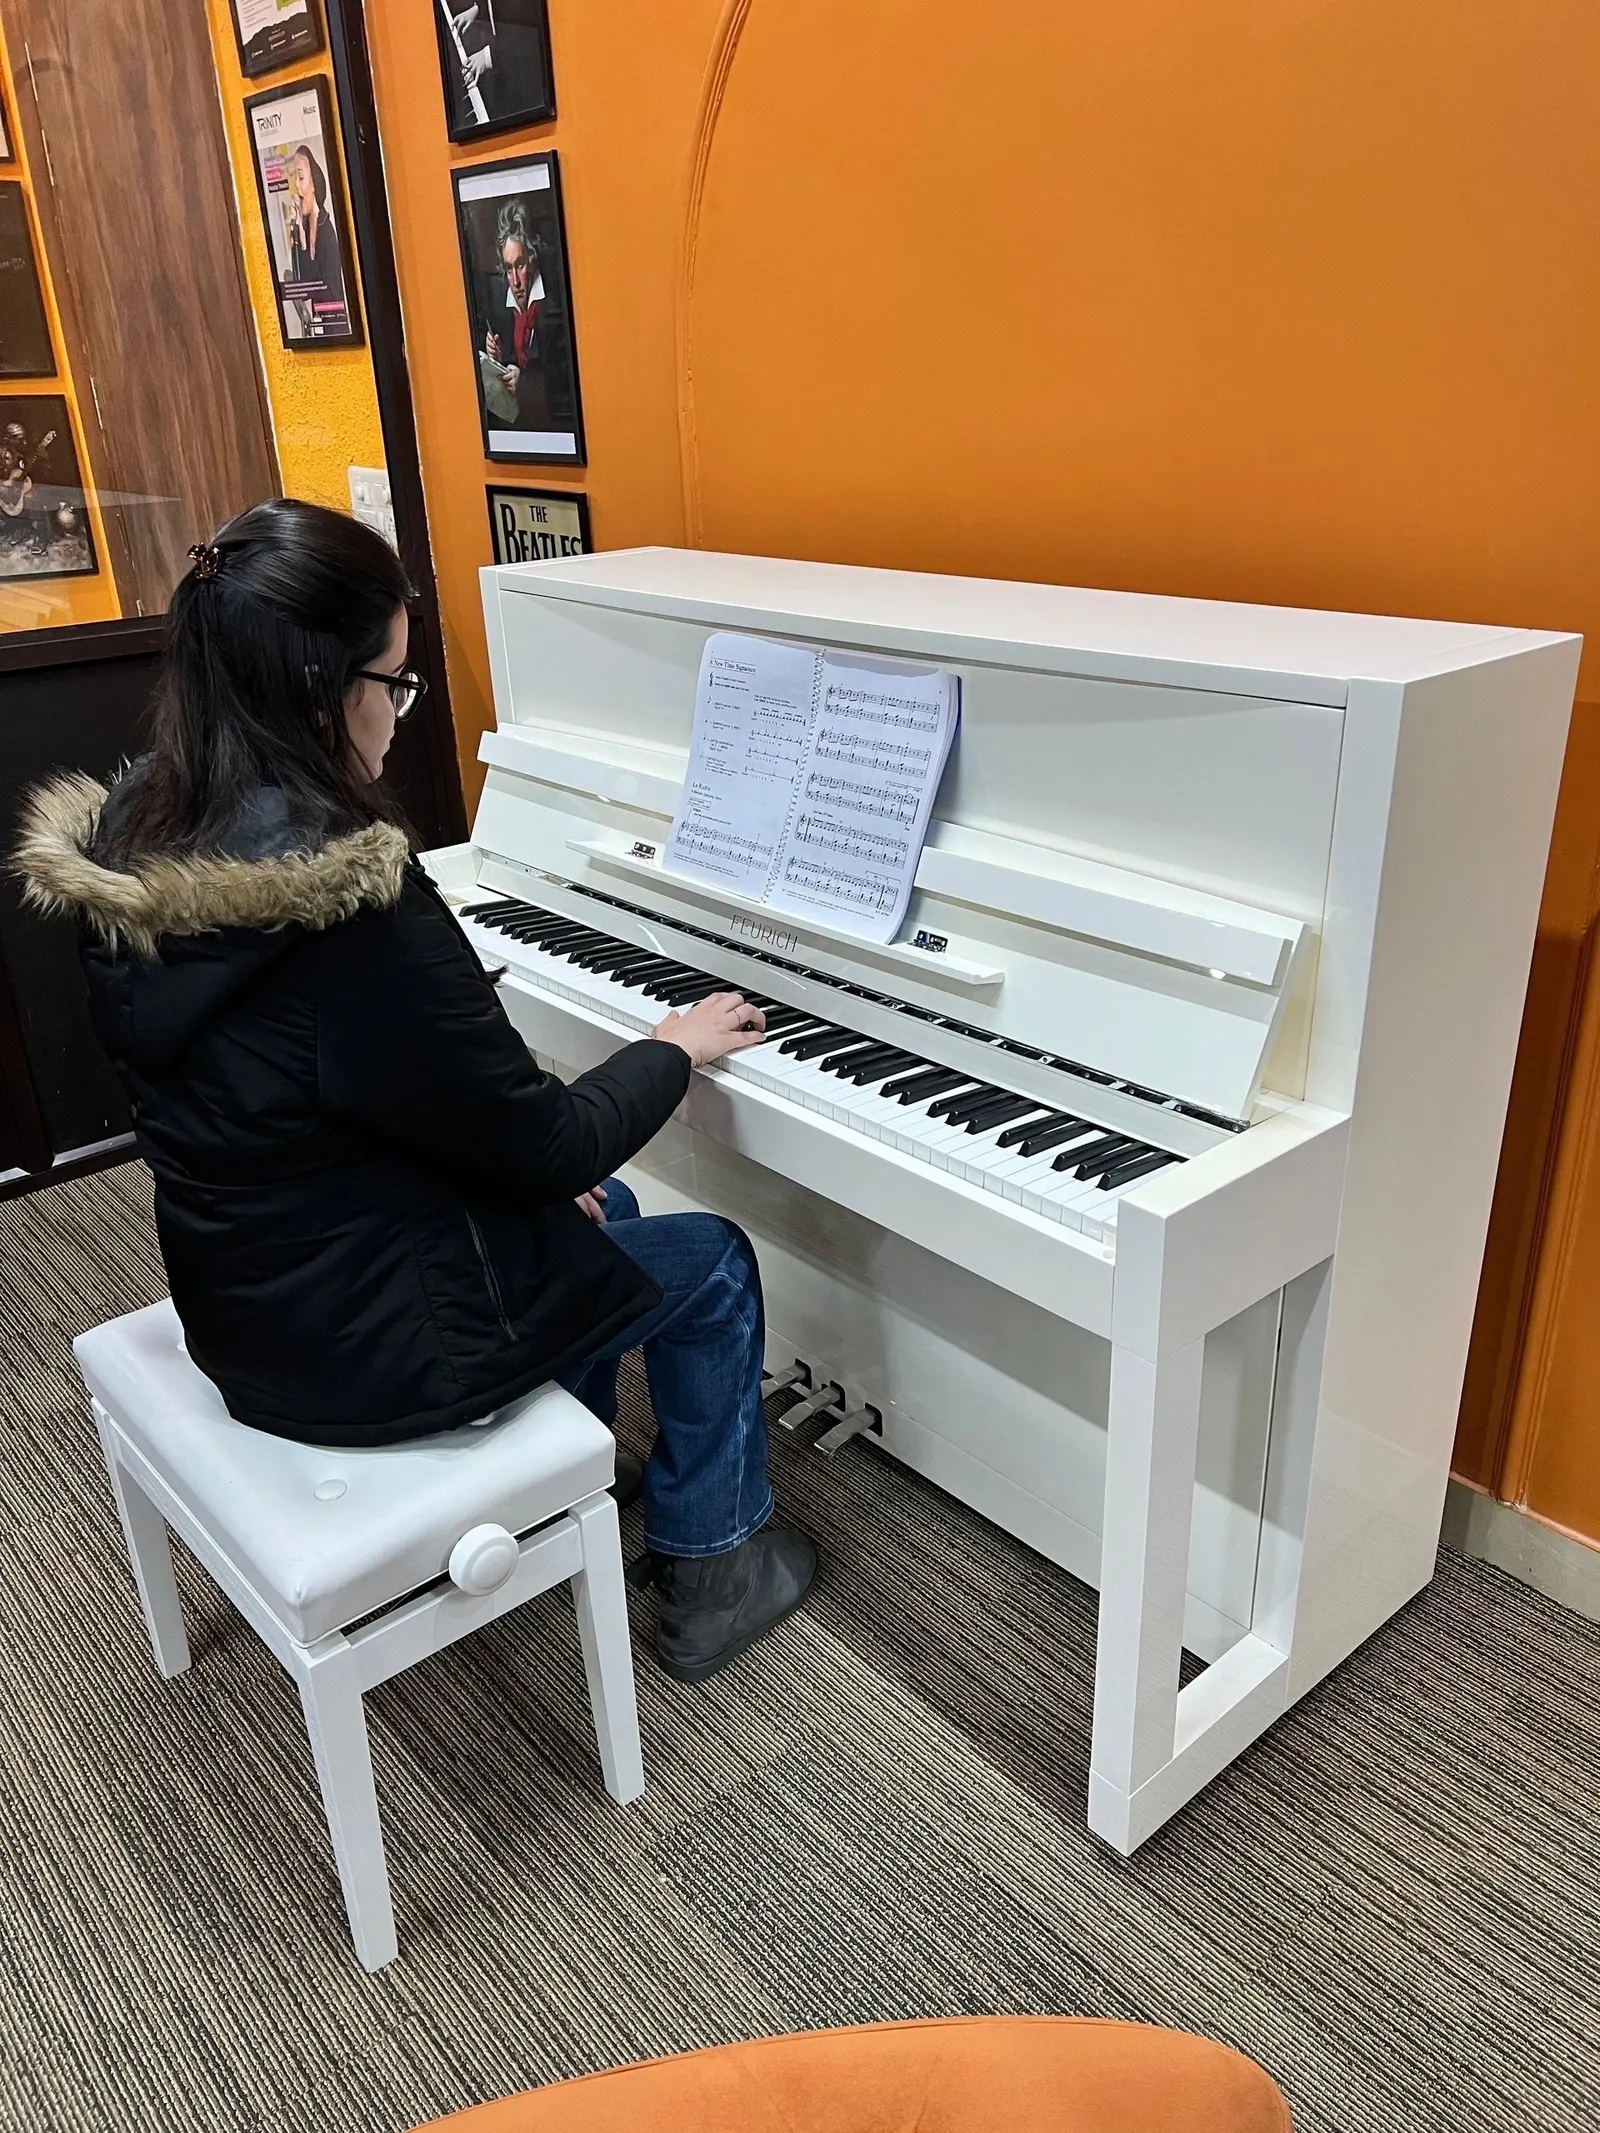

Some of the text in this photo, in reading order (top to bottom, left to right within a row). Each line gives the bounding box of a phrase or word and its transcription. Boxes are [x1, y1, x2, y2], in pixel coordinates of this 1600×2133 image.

[256, 112, 282, 131] TRINITY
[529, 505, 548, 523] THE
[730, 914, 798, 952] FEURICH
